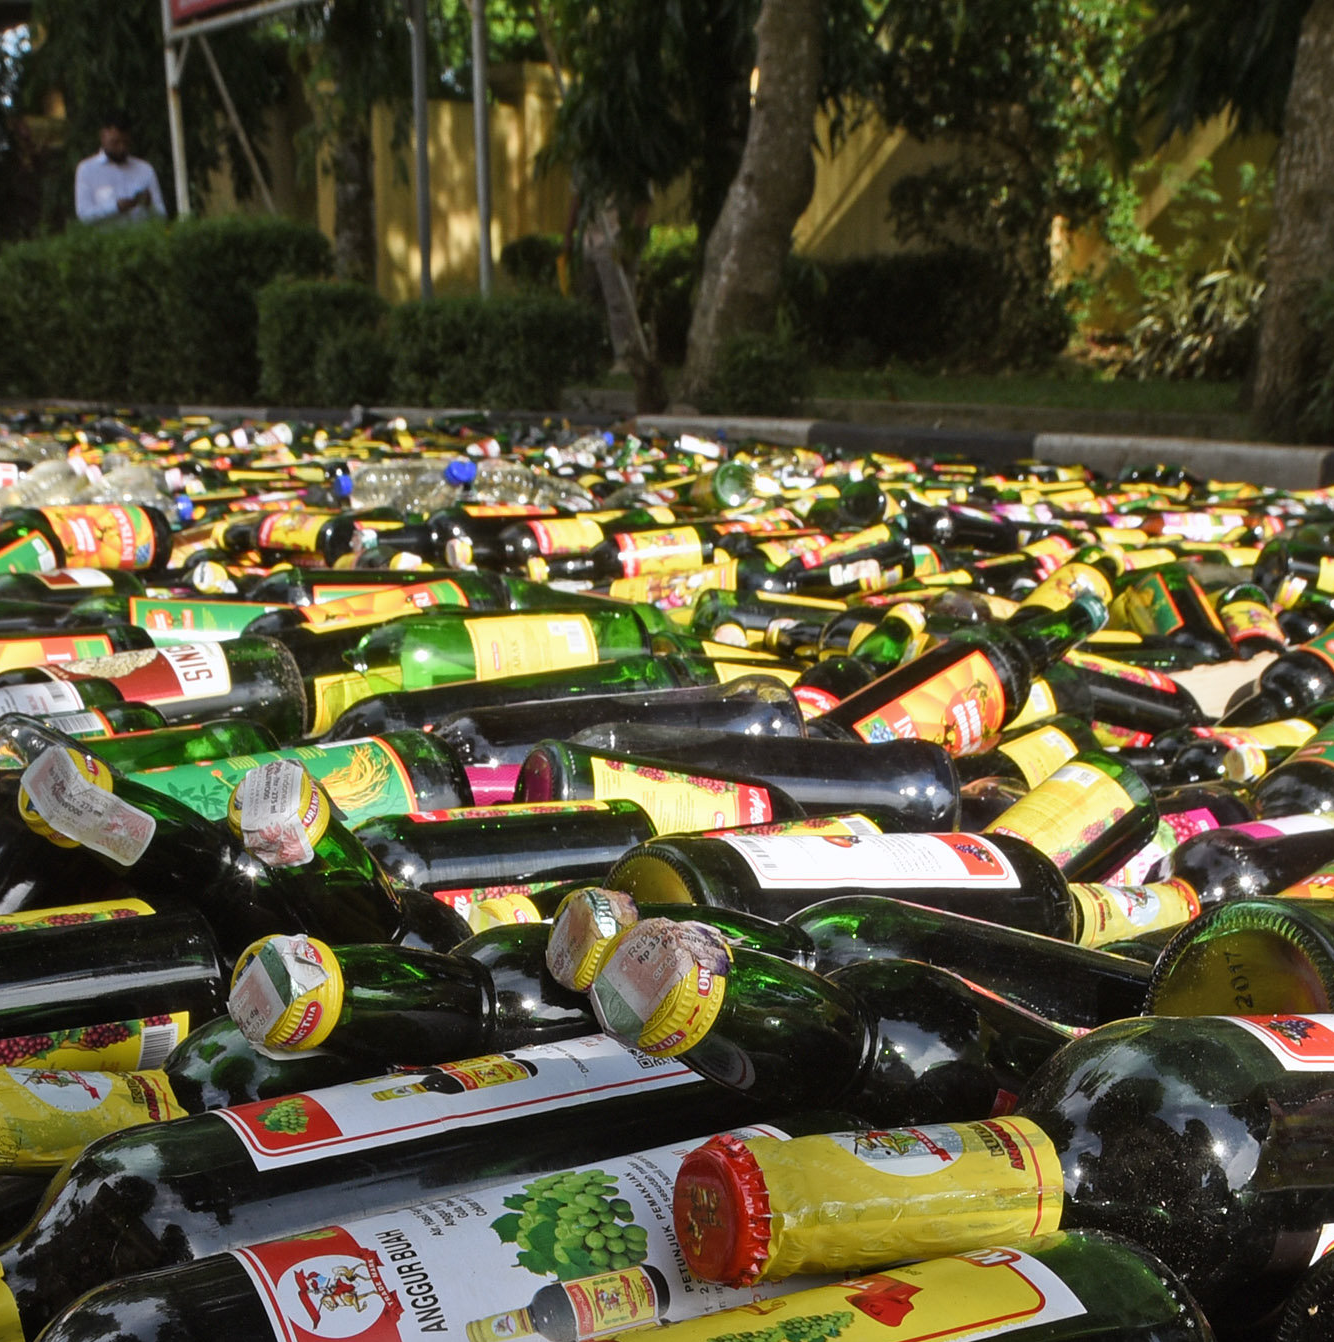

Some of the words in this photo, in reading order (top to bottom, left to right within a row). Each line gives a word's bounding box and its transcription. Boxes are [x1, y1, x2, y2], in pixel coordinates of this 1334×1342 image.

[375, 1227, 418, 1268] BUAH
[662, 1224, 695, 1294] PETUNJUK
[396, 1264, 449, 1333] ANGGUR
